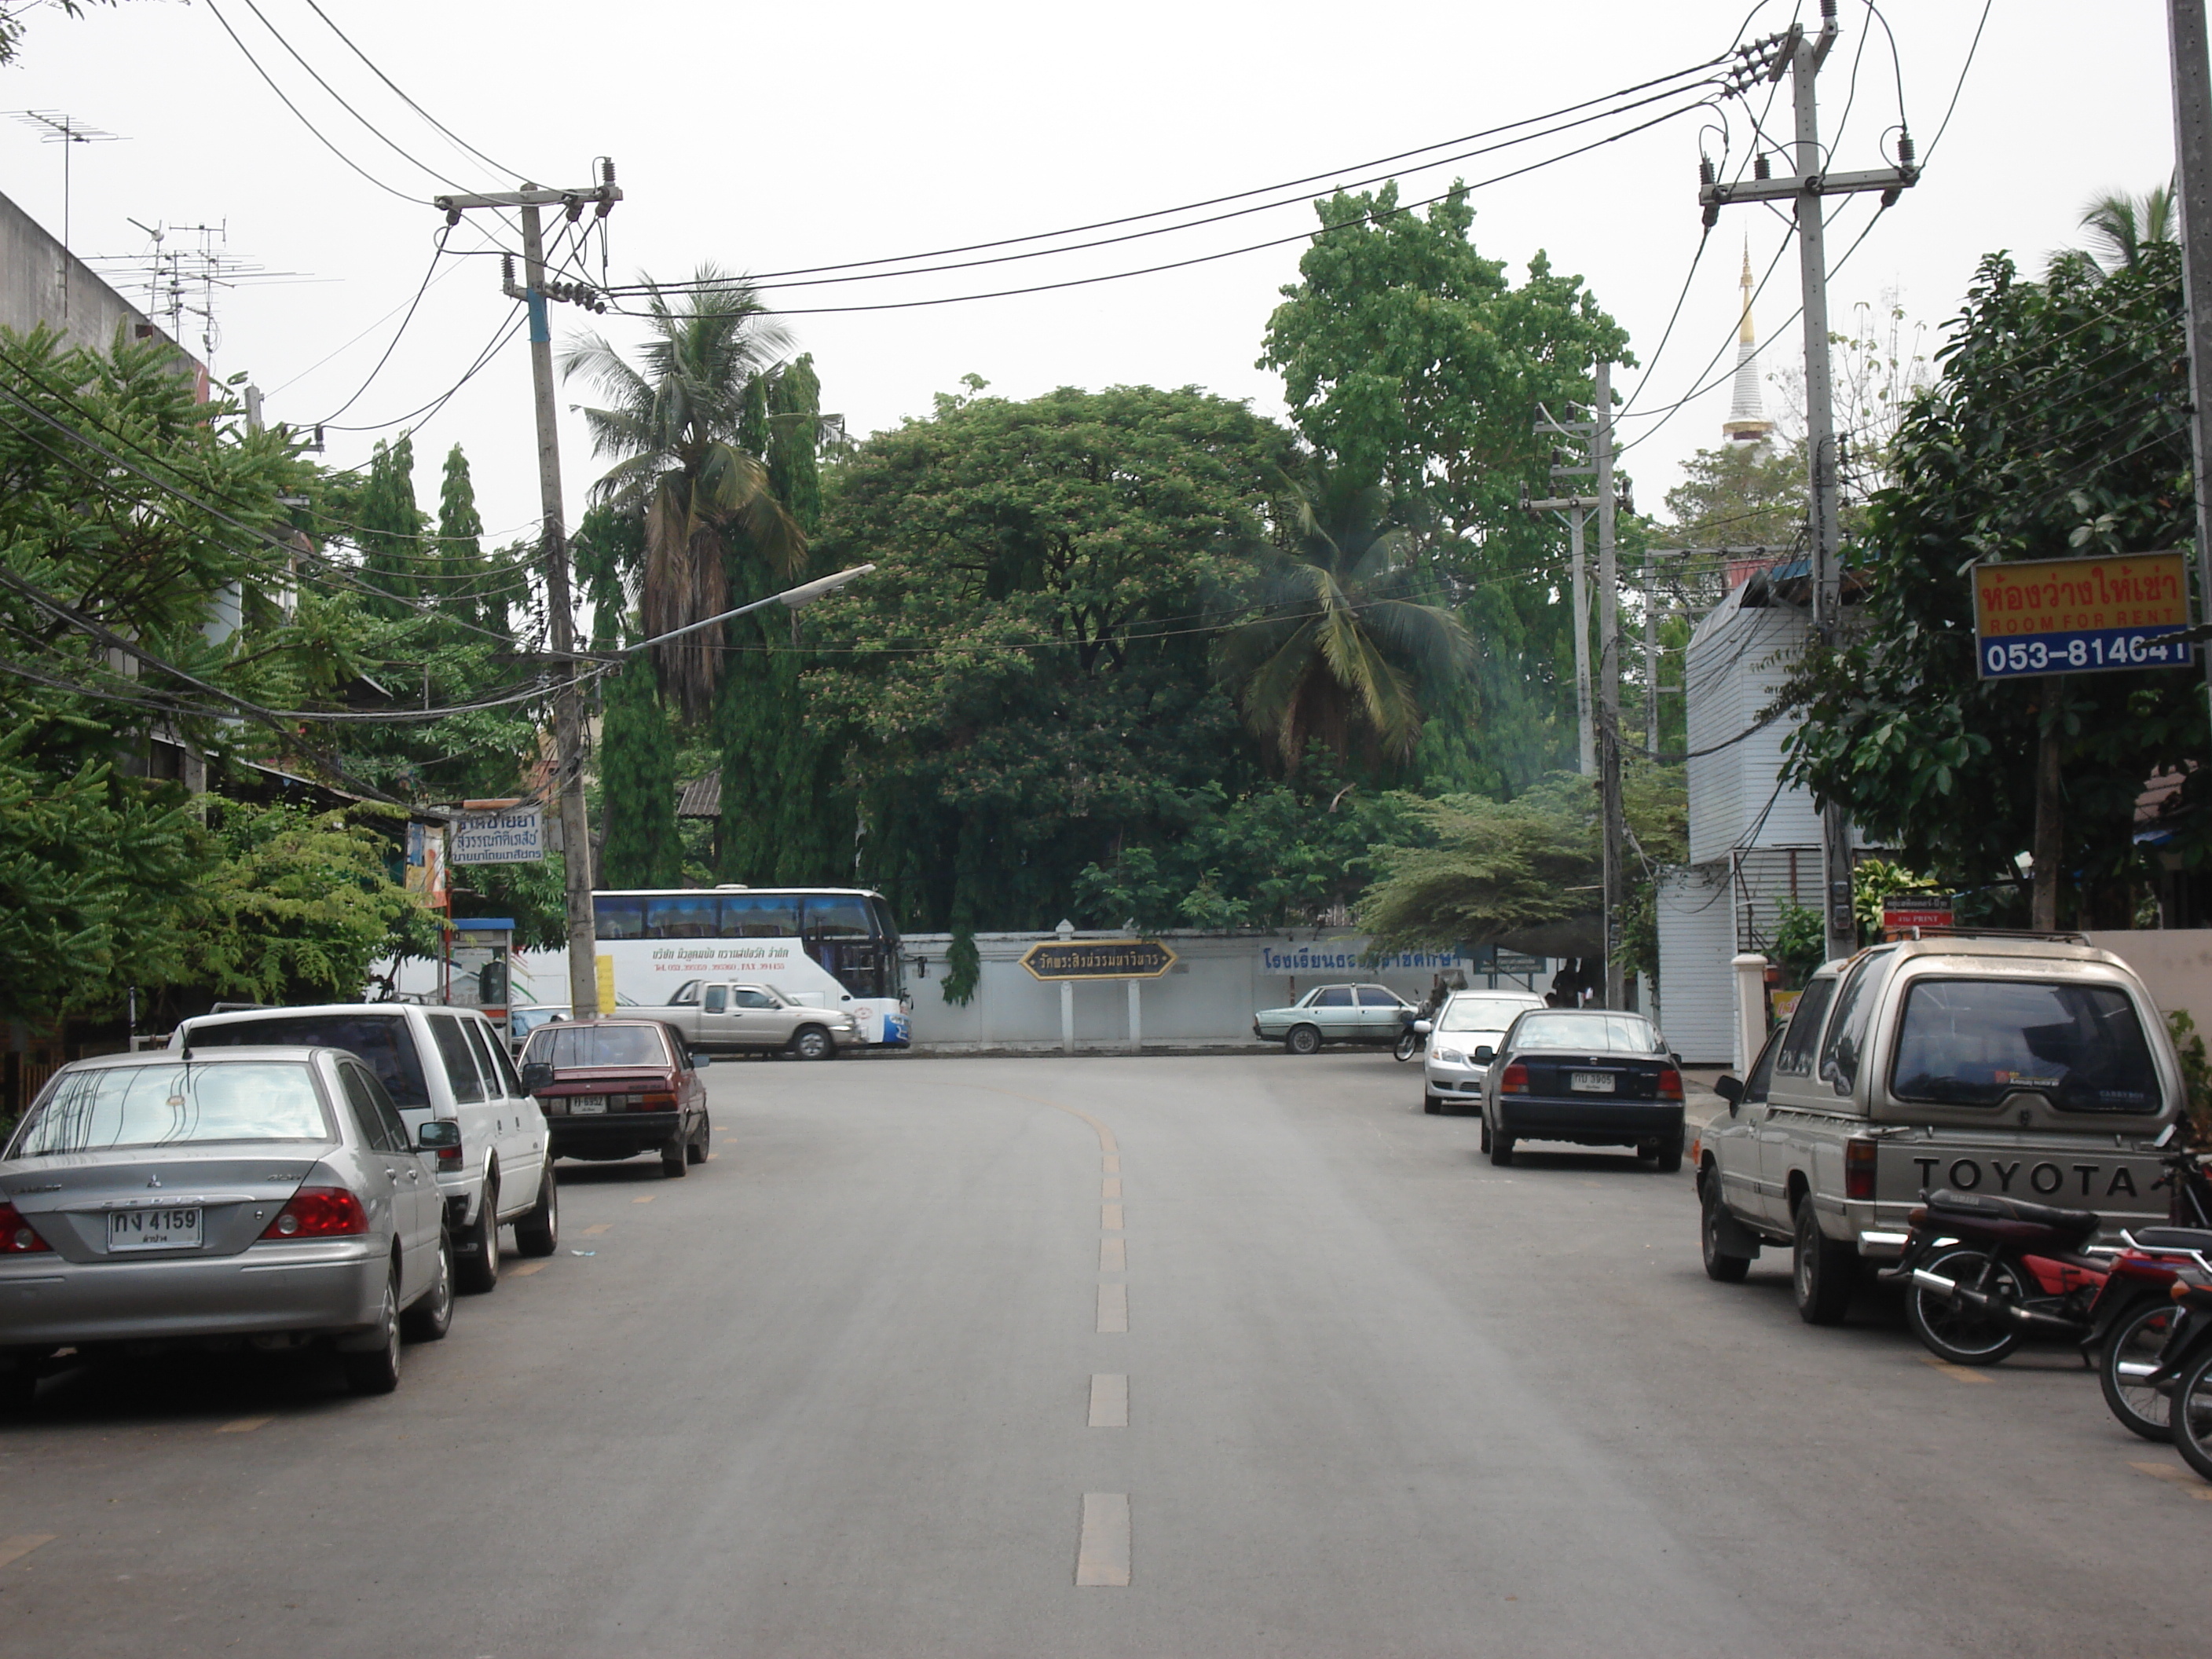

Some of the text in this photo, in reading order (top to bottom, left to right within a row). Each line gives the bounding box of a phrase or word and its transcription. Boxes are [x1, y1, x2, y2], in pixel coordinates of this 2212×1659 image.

[1982, 566, 2177, 612] ห้องว่างให้เช่า
[1990, 608, 2173, 633] ROOM FOR RENT
[1914, 1157, 2137, 1197] TOYOTA
[115, 1210, 196, 1232] กง 4159
